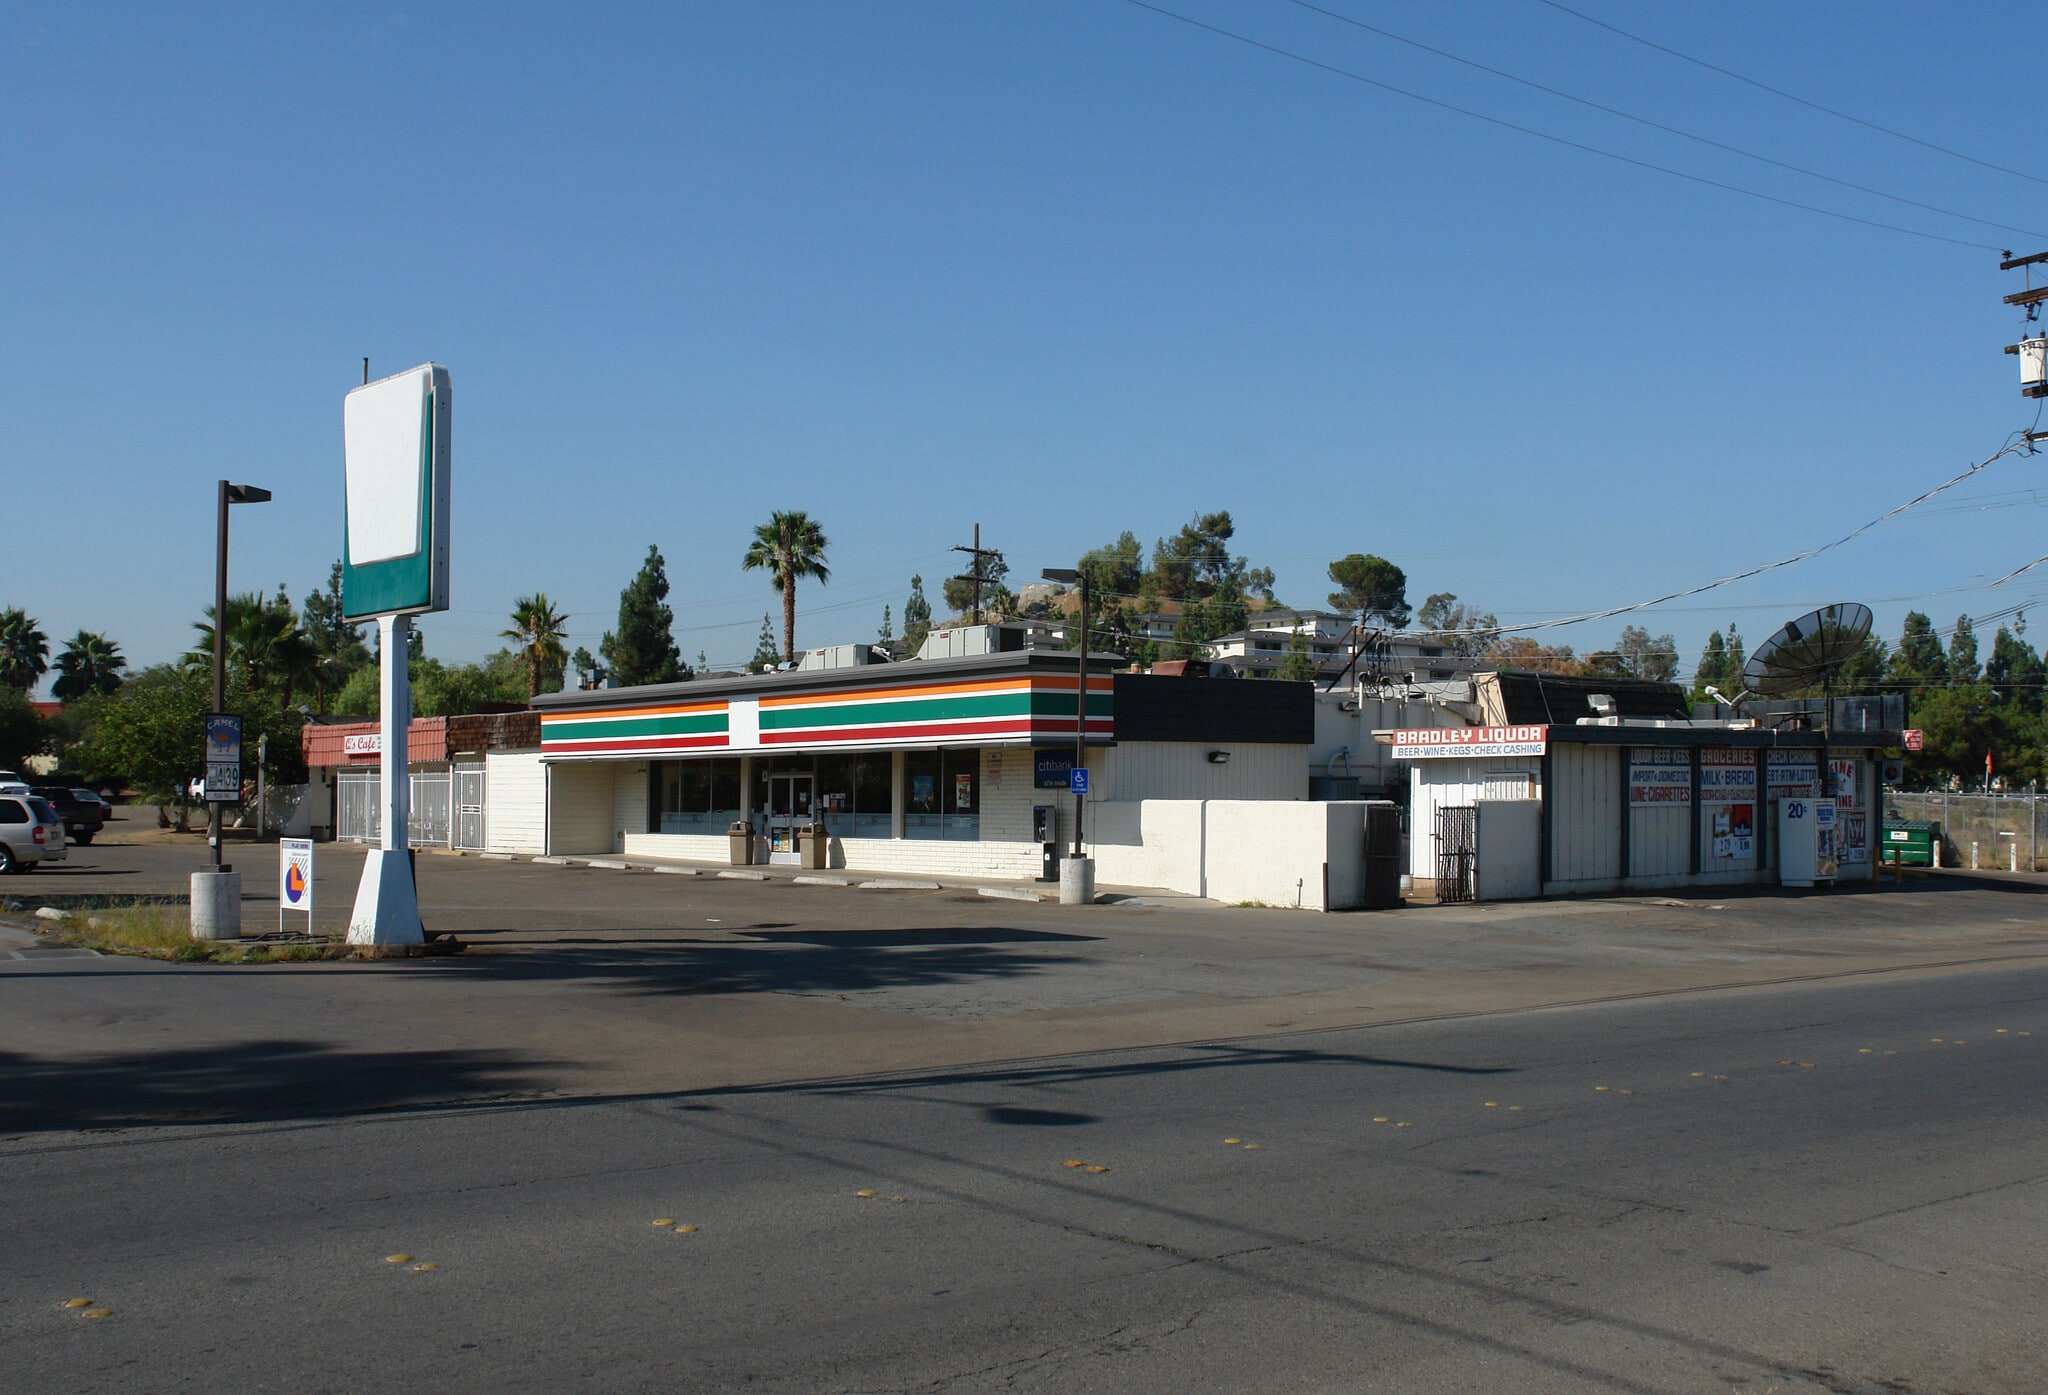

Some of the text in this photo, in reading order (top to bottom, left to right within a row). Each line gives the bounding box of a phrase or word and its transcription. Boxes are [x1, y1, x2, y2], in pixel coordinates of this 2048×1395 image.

[207, 719, 240, 731] CAMEL
[357, 736, 376, 751] Cafe
[1396, 727, 1541, 745] BRADLEY LIQUOR
[1398, 744, 1542, 757] BEER WINE KEGS CHECK CASHING
[1701, 749, 1755, 764] GROCERIES
[1038, 760, 1072, 772] citibank
[1658, 770, 1690, 782] DOMESTIC
[1701, 770, 1755, 786] MILK BREAD
[1648, 786, 1690, 802] CIGARETTES
